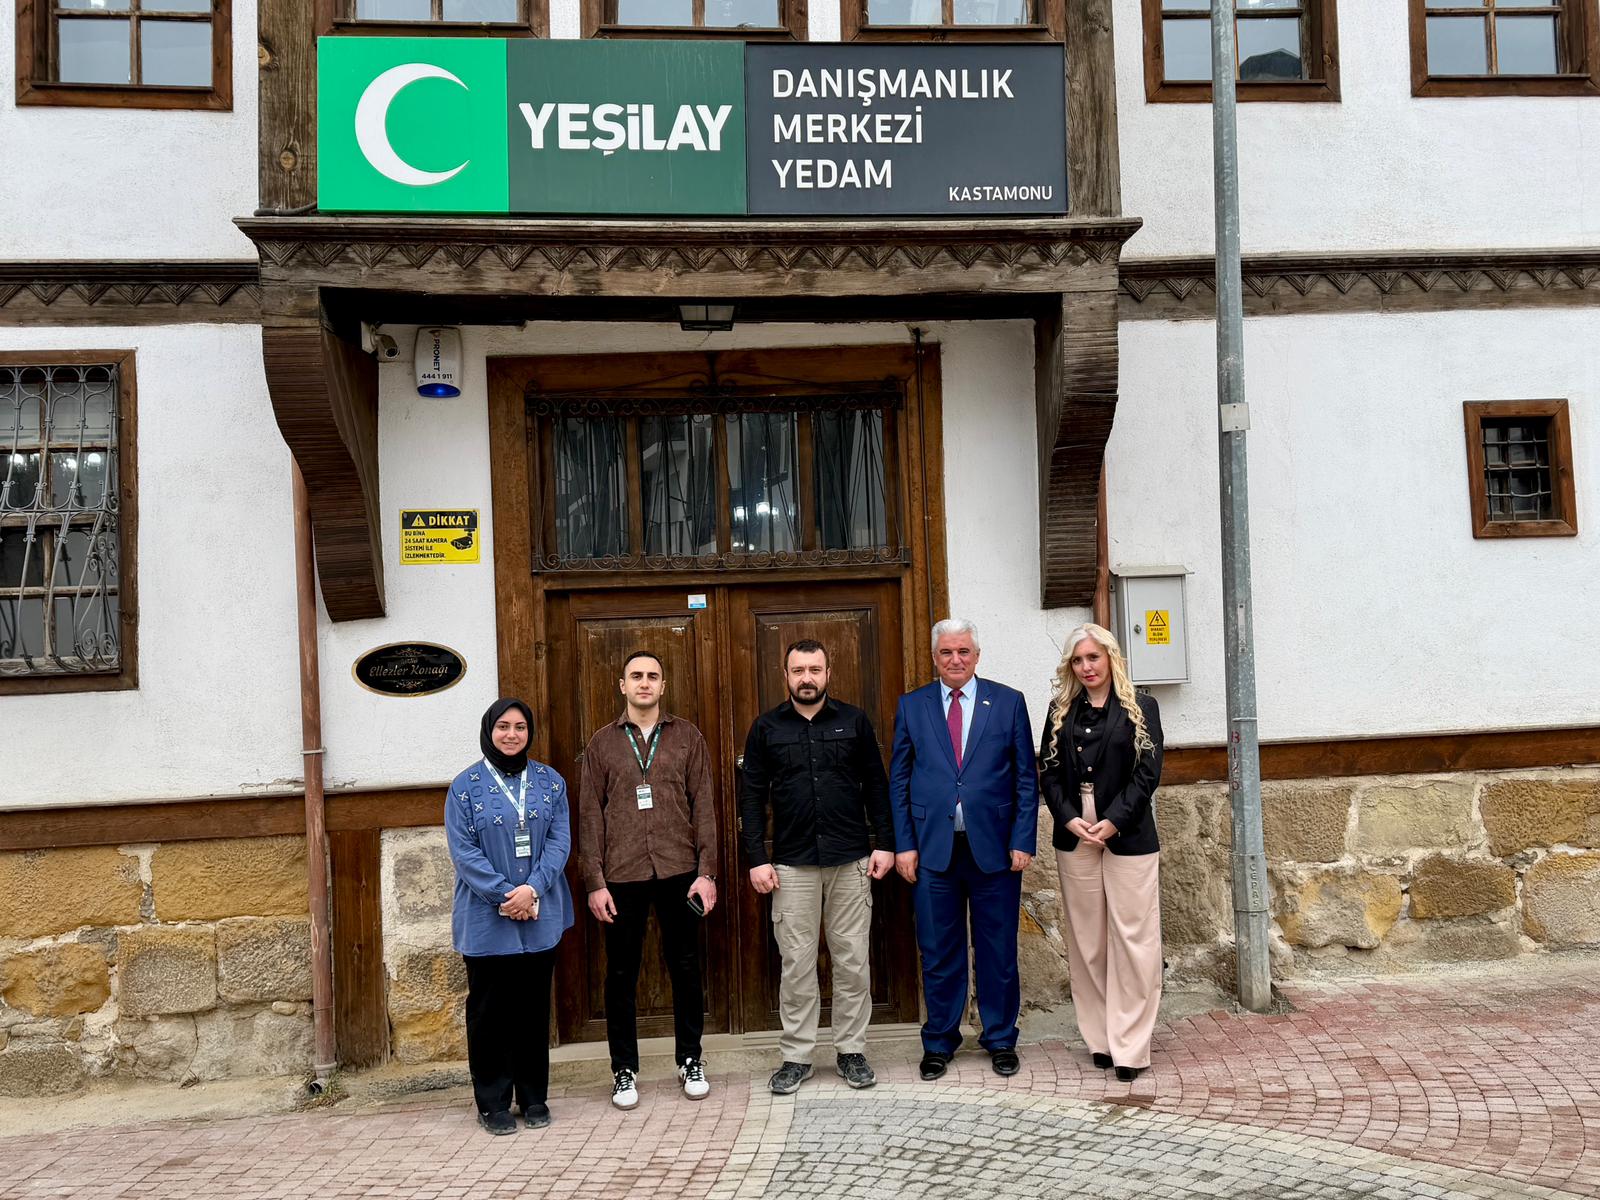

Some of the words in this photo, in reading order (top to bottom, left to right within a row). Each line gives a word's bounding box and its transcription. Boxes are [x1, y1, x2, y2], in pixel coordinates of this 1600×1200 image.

[772, 68, 1015, 107] DANIŞMANLIK
[773, 105, 924, 144] MERKEZİ
[771, 158, 893, 189] YEDAM
[949, 185, 1053, 202] KASTAMONU
[429, 514, 470, 526] DİKKAT
